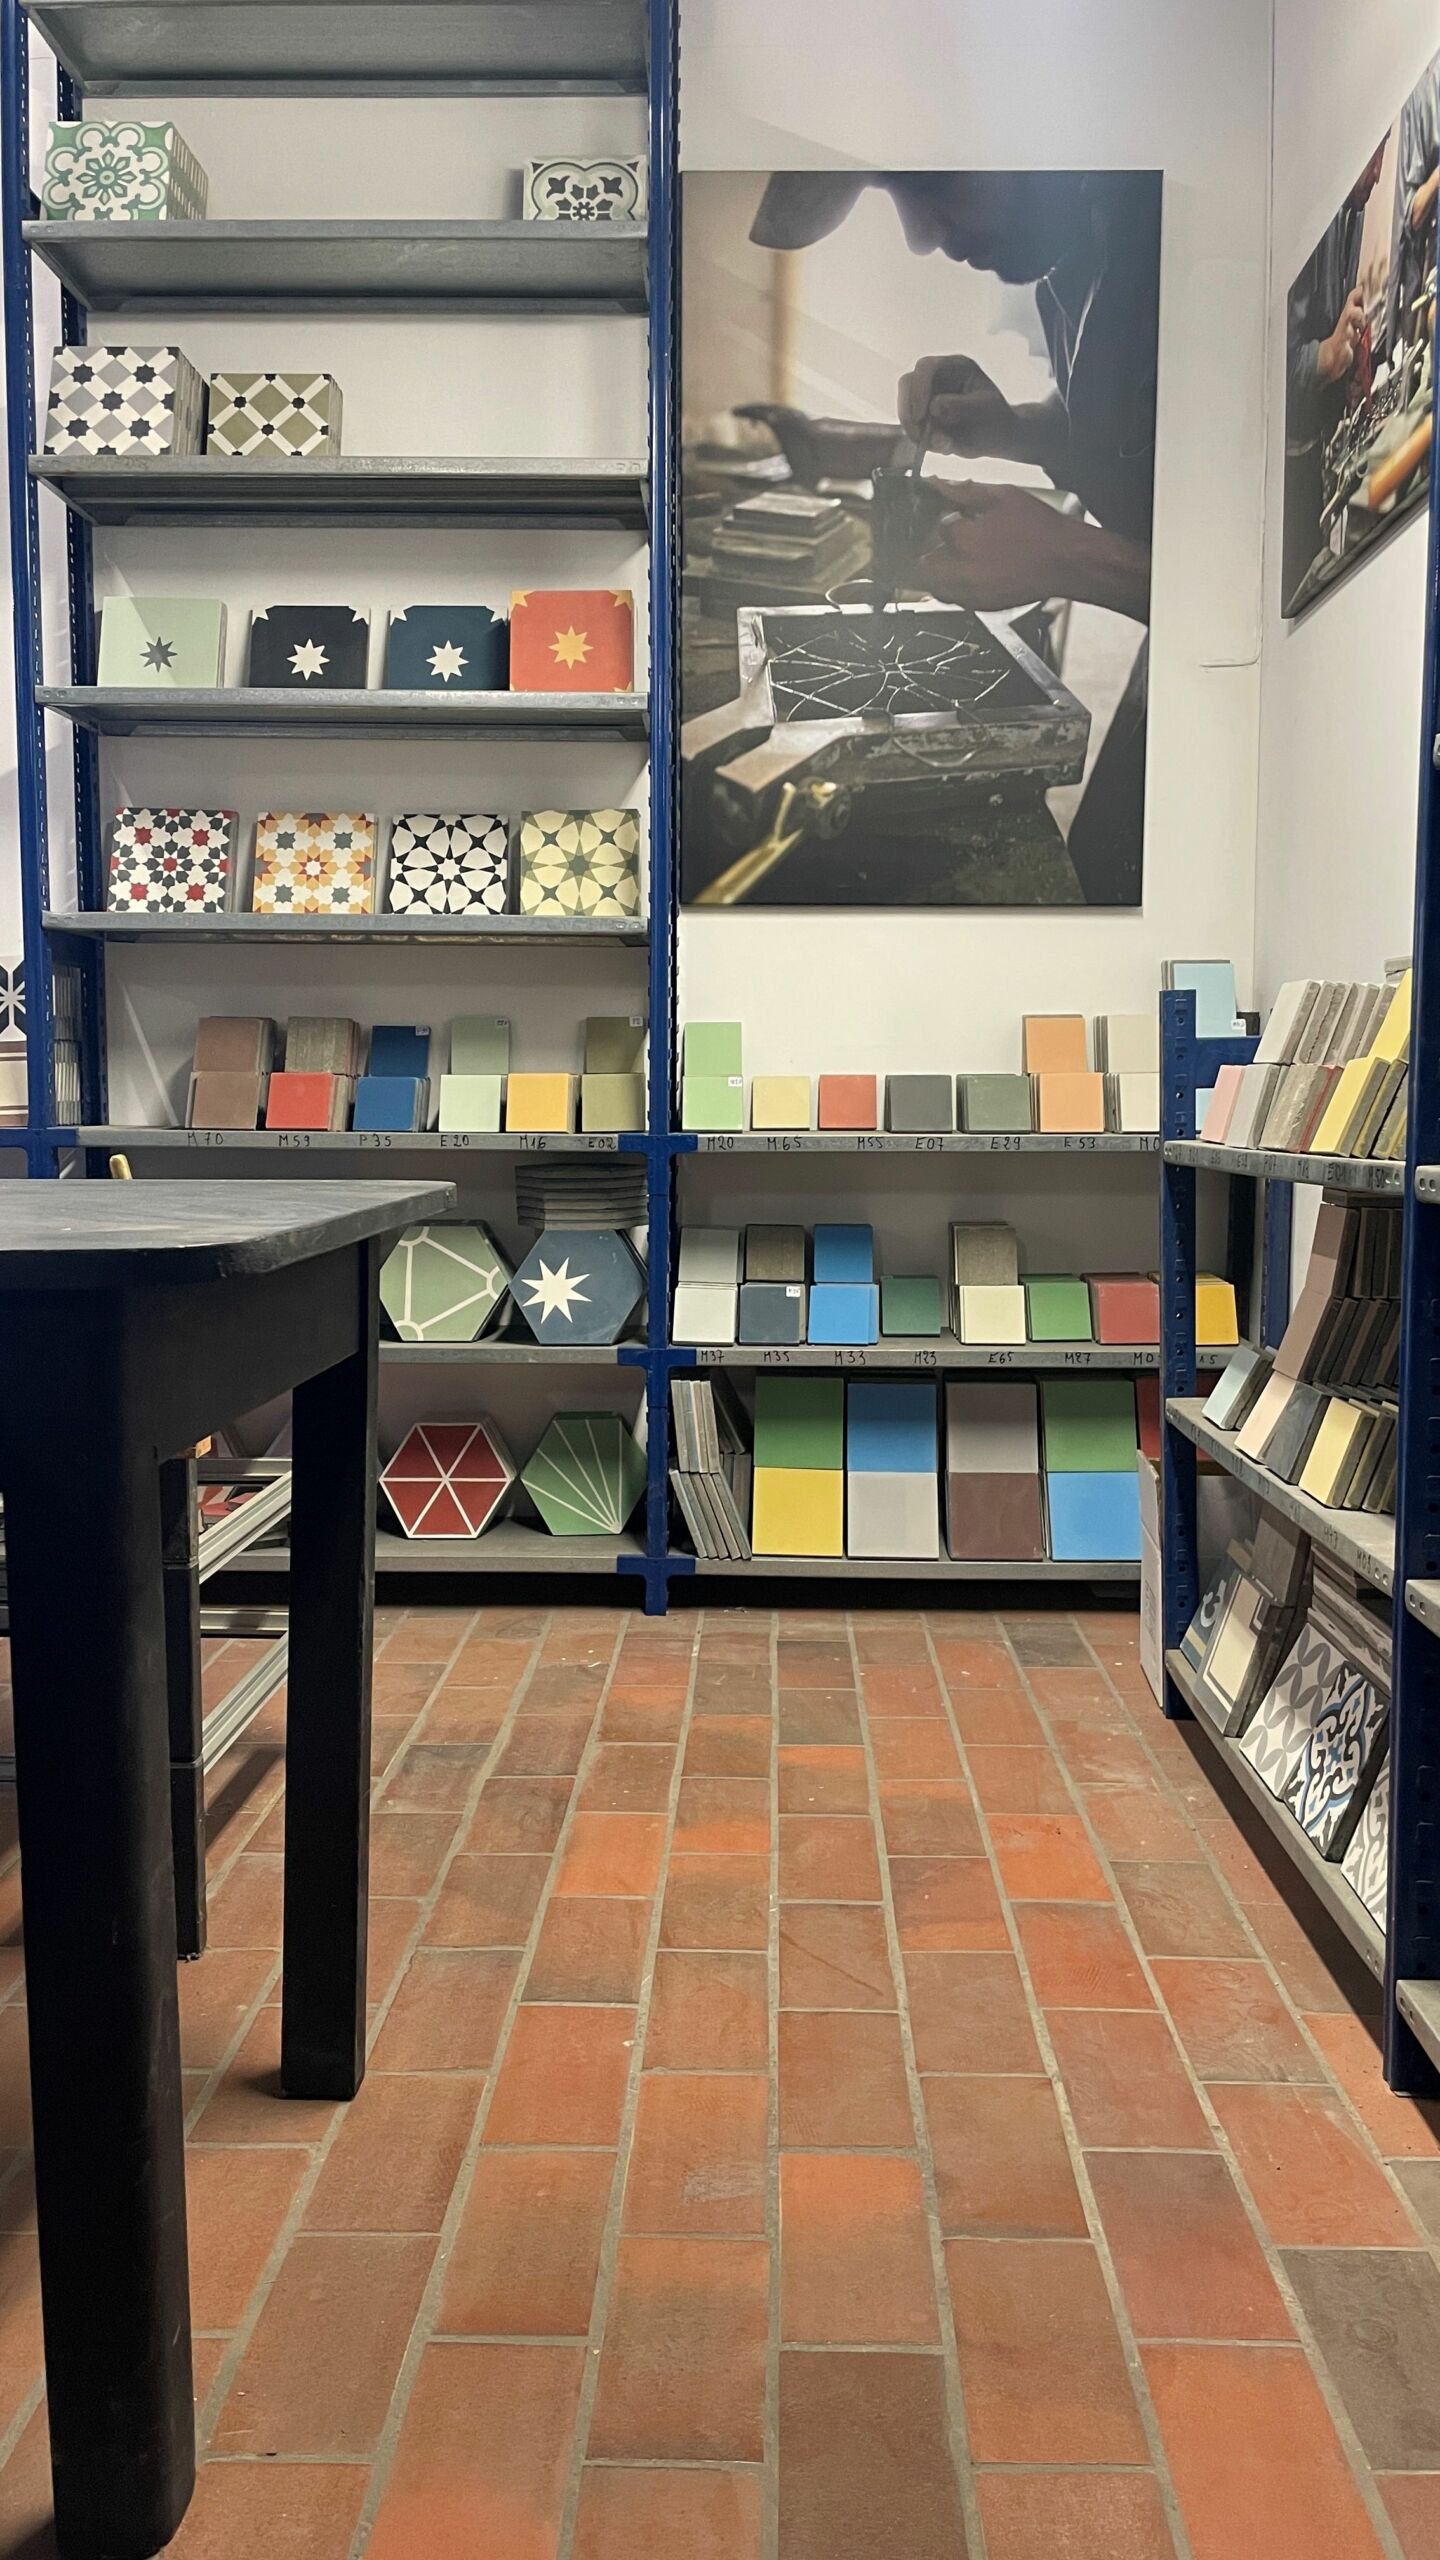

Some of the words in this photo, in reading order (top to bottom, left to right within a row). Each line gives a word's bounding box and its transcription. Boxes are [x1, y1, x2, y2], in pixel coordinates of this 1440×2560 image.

[186, 1131, 224, 1147] M70
[278, 1134, 311, 1147] M59
[359, 1133, 393, 1147] P35
[440, 1134, 470, 1147] E20
[519, 1133, 547, 1150] M16
[588, 1136, 617, 1150] E02
[707, 1135, 735, 1150] M20
[767, 1136, 803, 1151] M65
[857, 1136, 885, 1150] M55
[915, 1136, 944, 1150] E07
[990, 1136, 1021, 1150] E29
[1063, 1136, 1096, 1149] E53
[1139, 1136, 1160, 1151] M0
[700, 1350, 725, 1362] M37
[763, 1350, 791, 1362] M35
[834, 1350, 867, 1366] M33
[914, 1350, 938, 1365] M23
[988, 1351, 1015, 1364] E65
[1064, 1352, 1092, 1364] M27
[1133, 1351, 1161, 1364] M0
